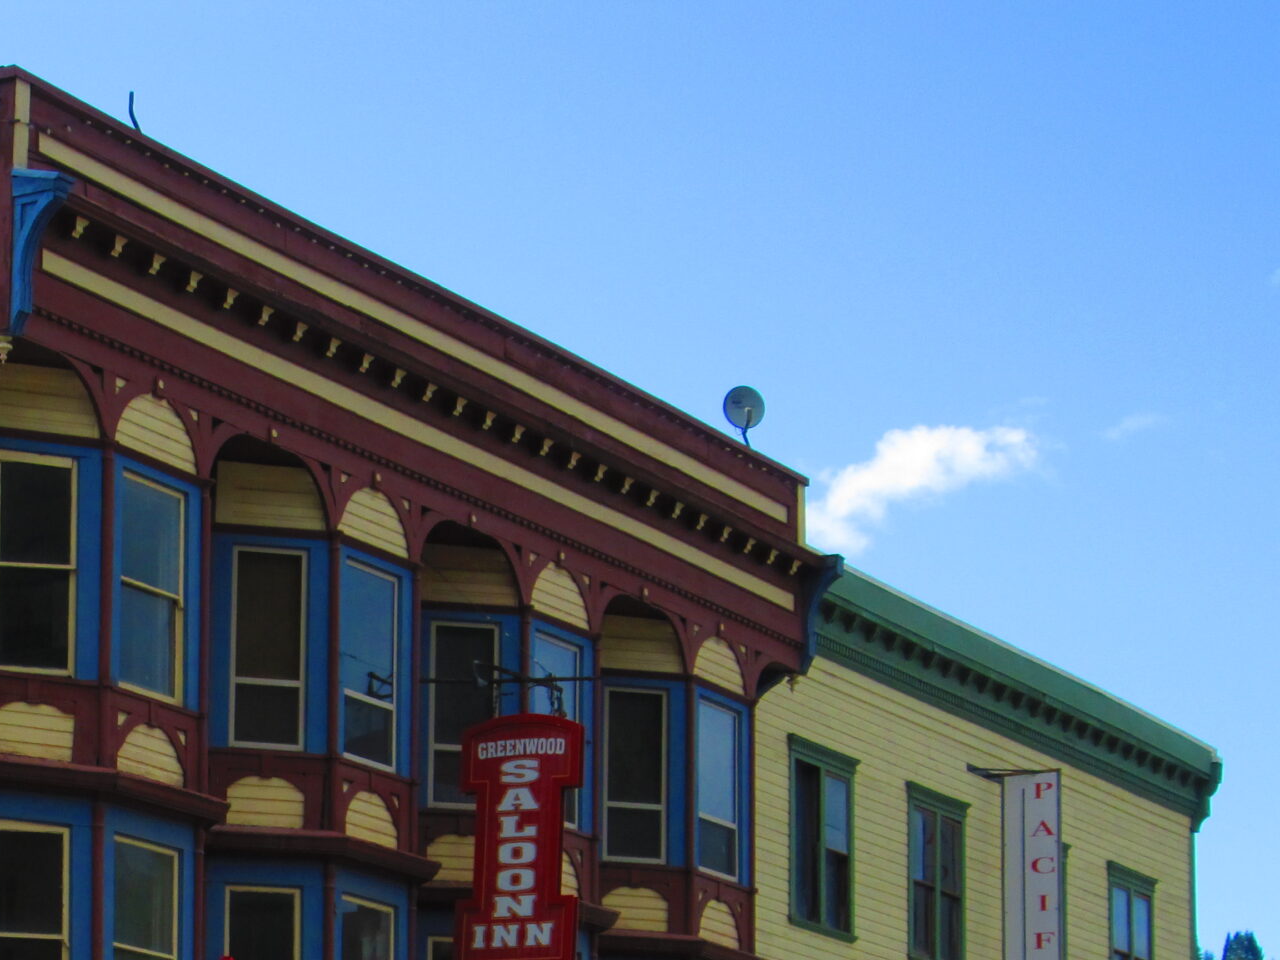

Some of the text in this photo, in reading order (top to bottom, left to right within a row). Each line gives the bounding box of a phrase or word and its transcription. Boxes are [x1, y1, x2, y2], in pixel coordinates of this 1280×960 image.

[477, 738, 566, 760] GREENWOOD
[493, 759, 540, 918] SALOON
[472, 922, 554, 949] INN
